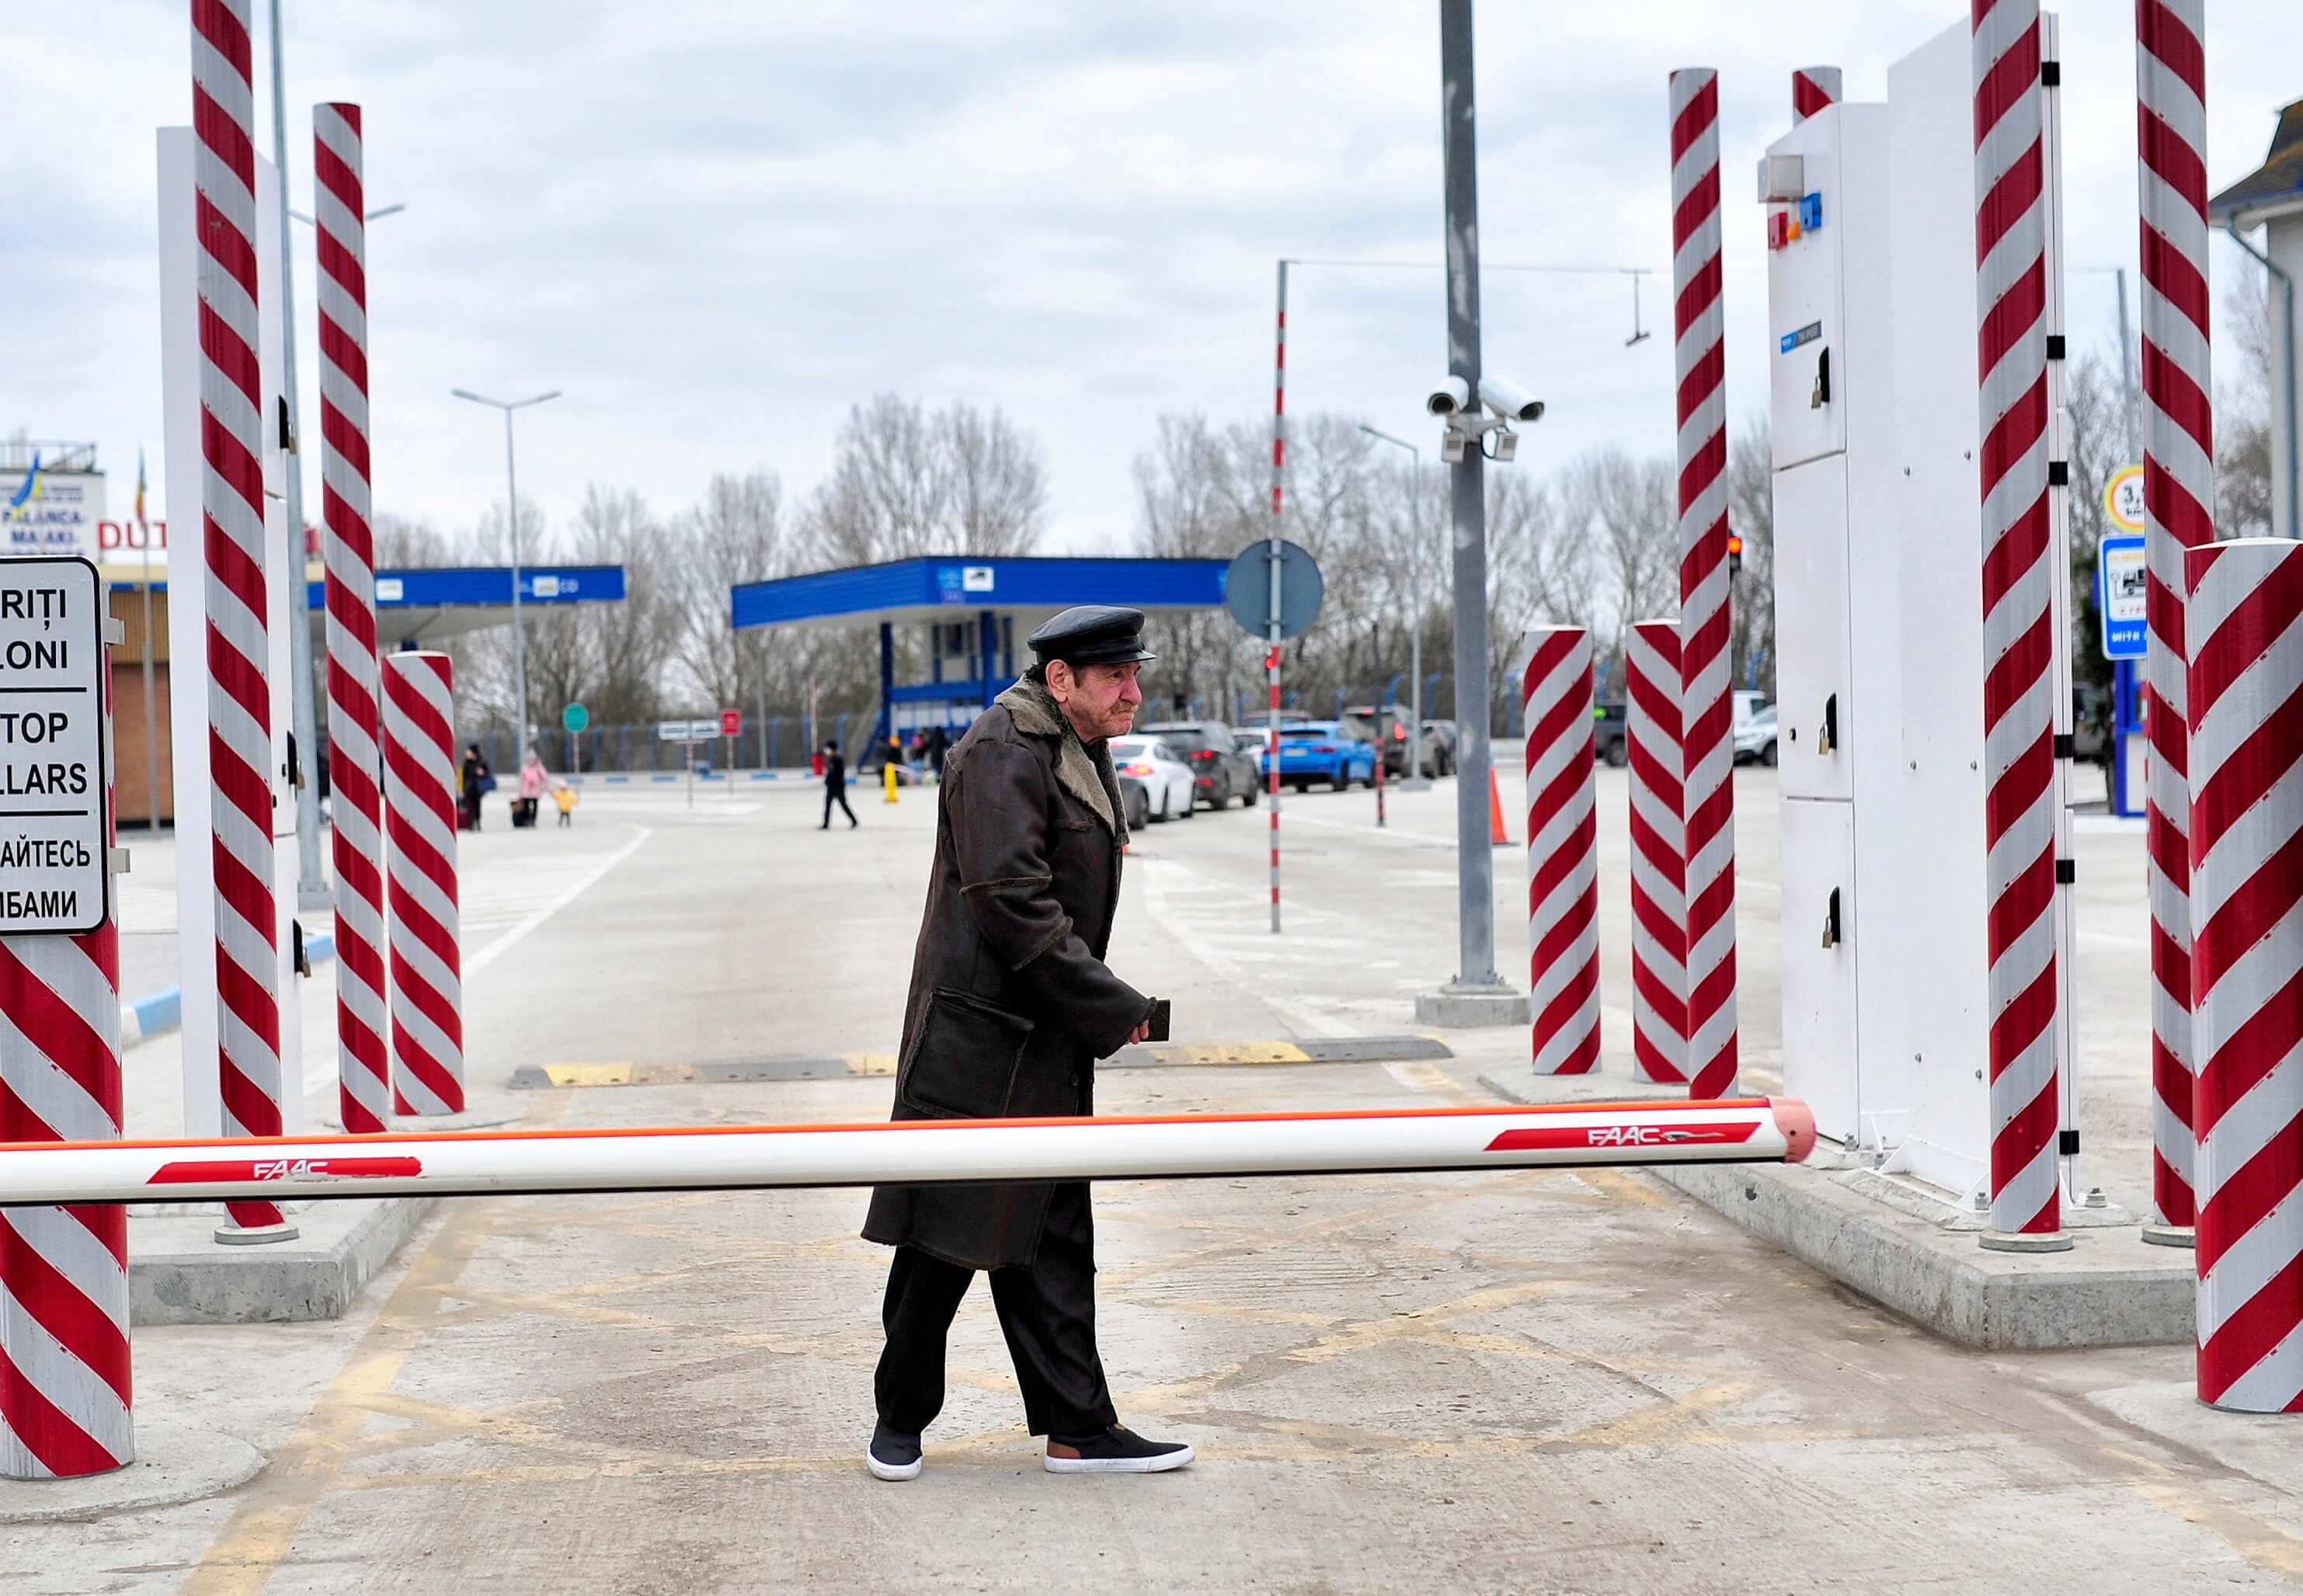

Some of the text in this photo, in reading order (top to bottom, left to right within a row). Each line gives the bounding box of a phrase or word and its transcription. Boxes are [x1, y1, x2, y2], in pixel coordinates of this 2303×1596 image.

[0, 641, 67, 669] ONI
[0, 712, 68, 743] TOP
[0, 763, 87, 795] LARS
[0, 833, 90, 868] АЙТЕСЬ
[1588, 1126, 1660, 1146] FAAC
[254, 1160, 328, 1180] FAAC
